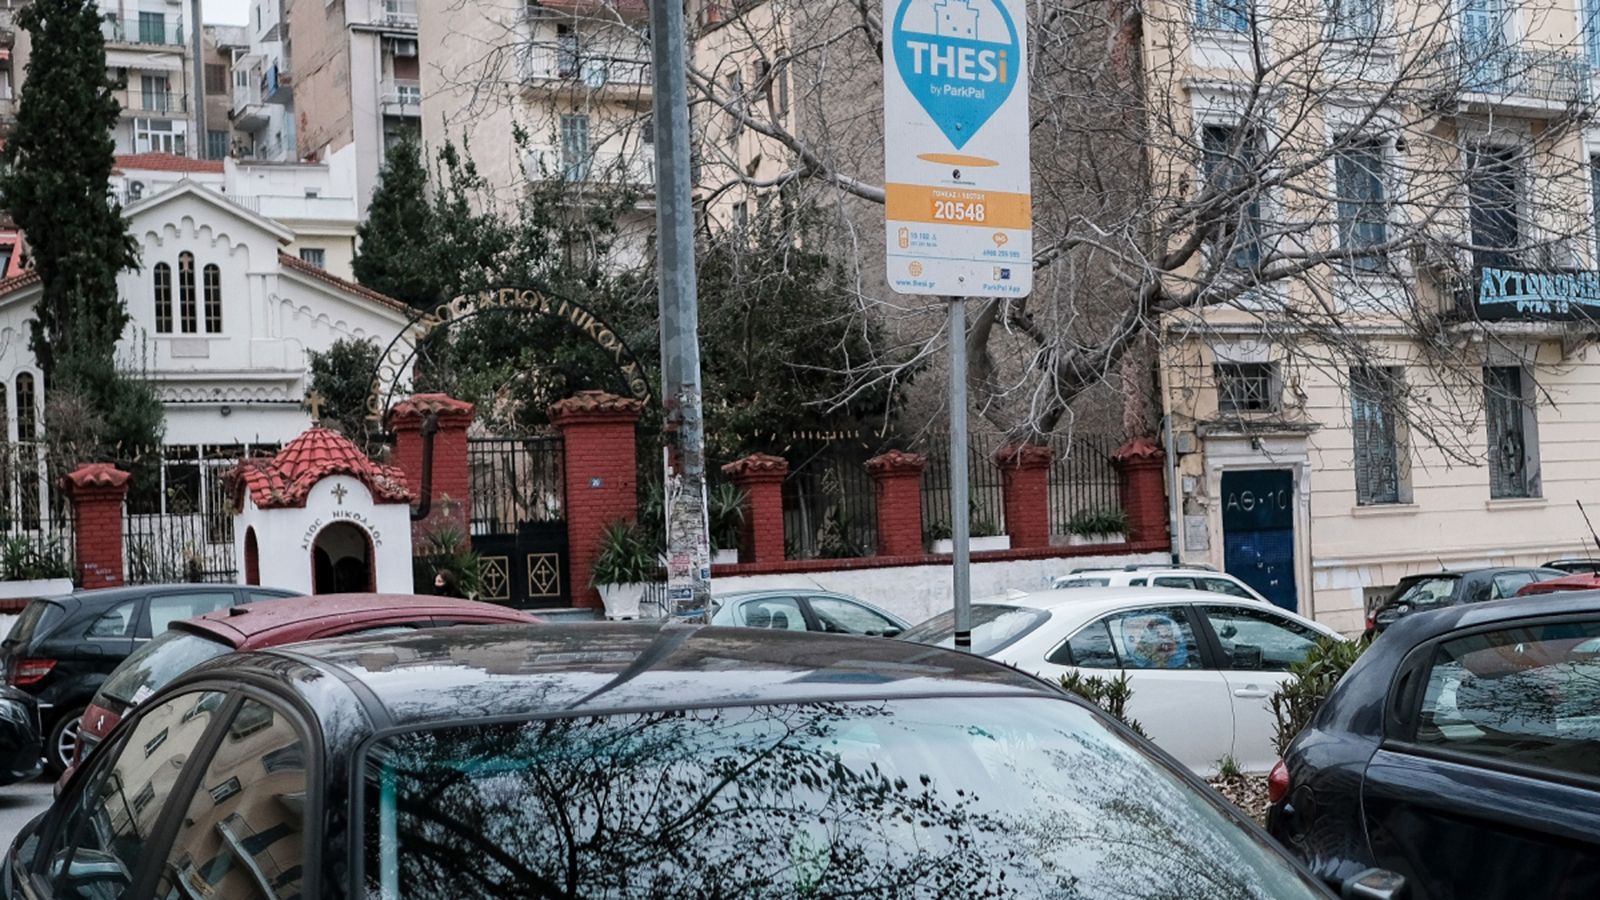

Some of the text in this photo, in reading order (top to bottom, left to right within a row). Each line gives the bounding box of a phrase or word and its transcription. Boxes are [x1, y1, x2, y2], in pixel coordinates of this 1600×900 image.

[906, 40, 1007, 84] THESi
[930, 83, 985, 99] by ParkPal
[934, 200, 985, 222] 20548
